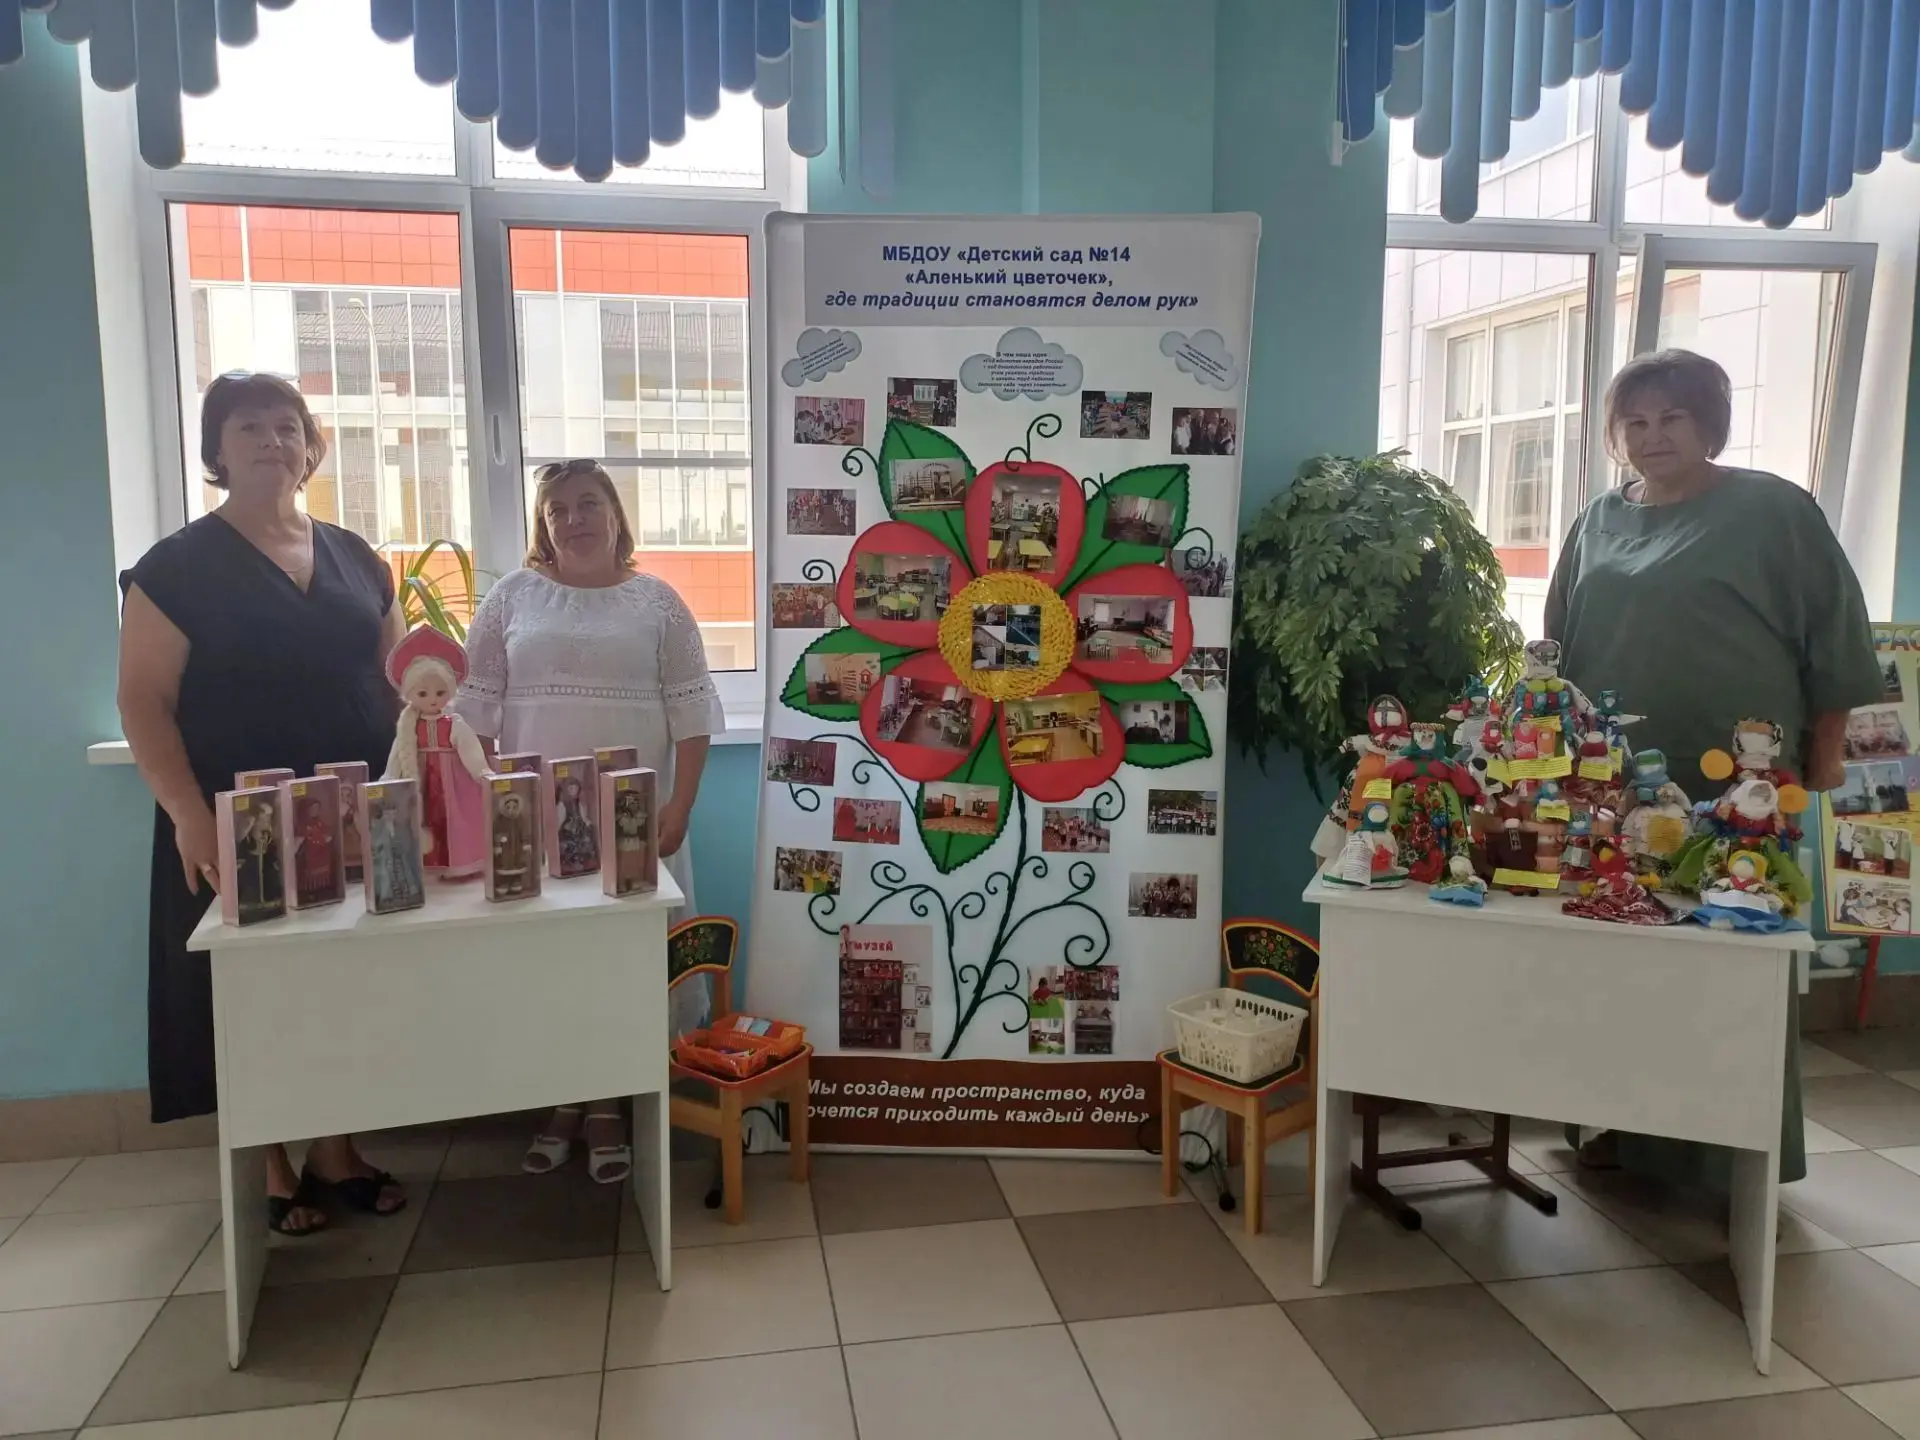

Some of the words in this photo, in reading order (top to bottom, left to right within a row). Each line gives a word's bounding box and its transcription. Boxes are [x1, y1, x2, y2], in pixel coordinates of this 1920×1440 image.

[883, 246, 951, 264] МБДОУ
[957, 245, 1043, 264] «Детский
[1050, 250, 1082, 264] сад
[1089, 246, 1130, 262] №14
[905, 269, 1006, 285] «Аленький
[1013, 272, 1113, 288] цветочек»,
[825, 291, 857, 308] где
[862, 292, 960, 310] традиции
[966, 294, 1087, 308] становятся
[1092, 291, 1152, 309] делом
[1156, 295, 1199, 312] рук»
[844, 1080, 925, 1099] создаем
[931, 1084, 1092, 1102] пространство,
[1099, 1084, 1146, 1101] куда
[807, 1105, 879, 1119] очется
[884, 1105, 999, 1123] приходить
[1005, 1107, 1084, 1124] каждый
[1091, 1107, 1150, 1124] день»
